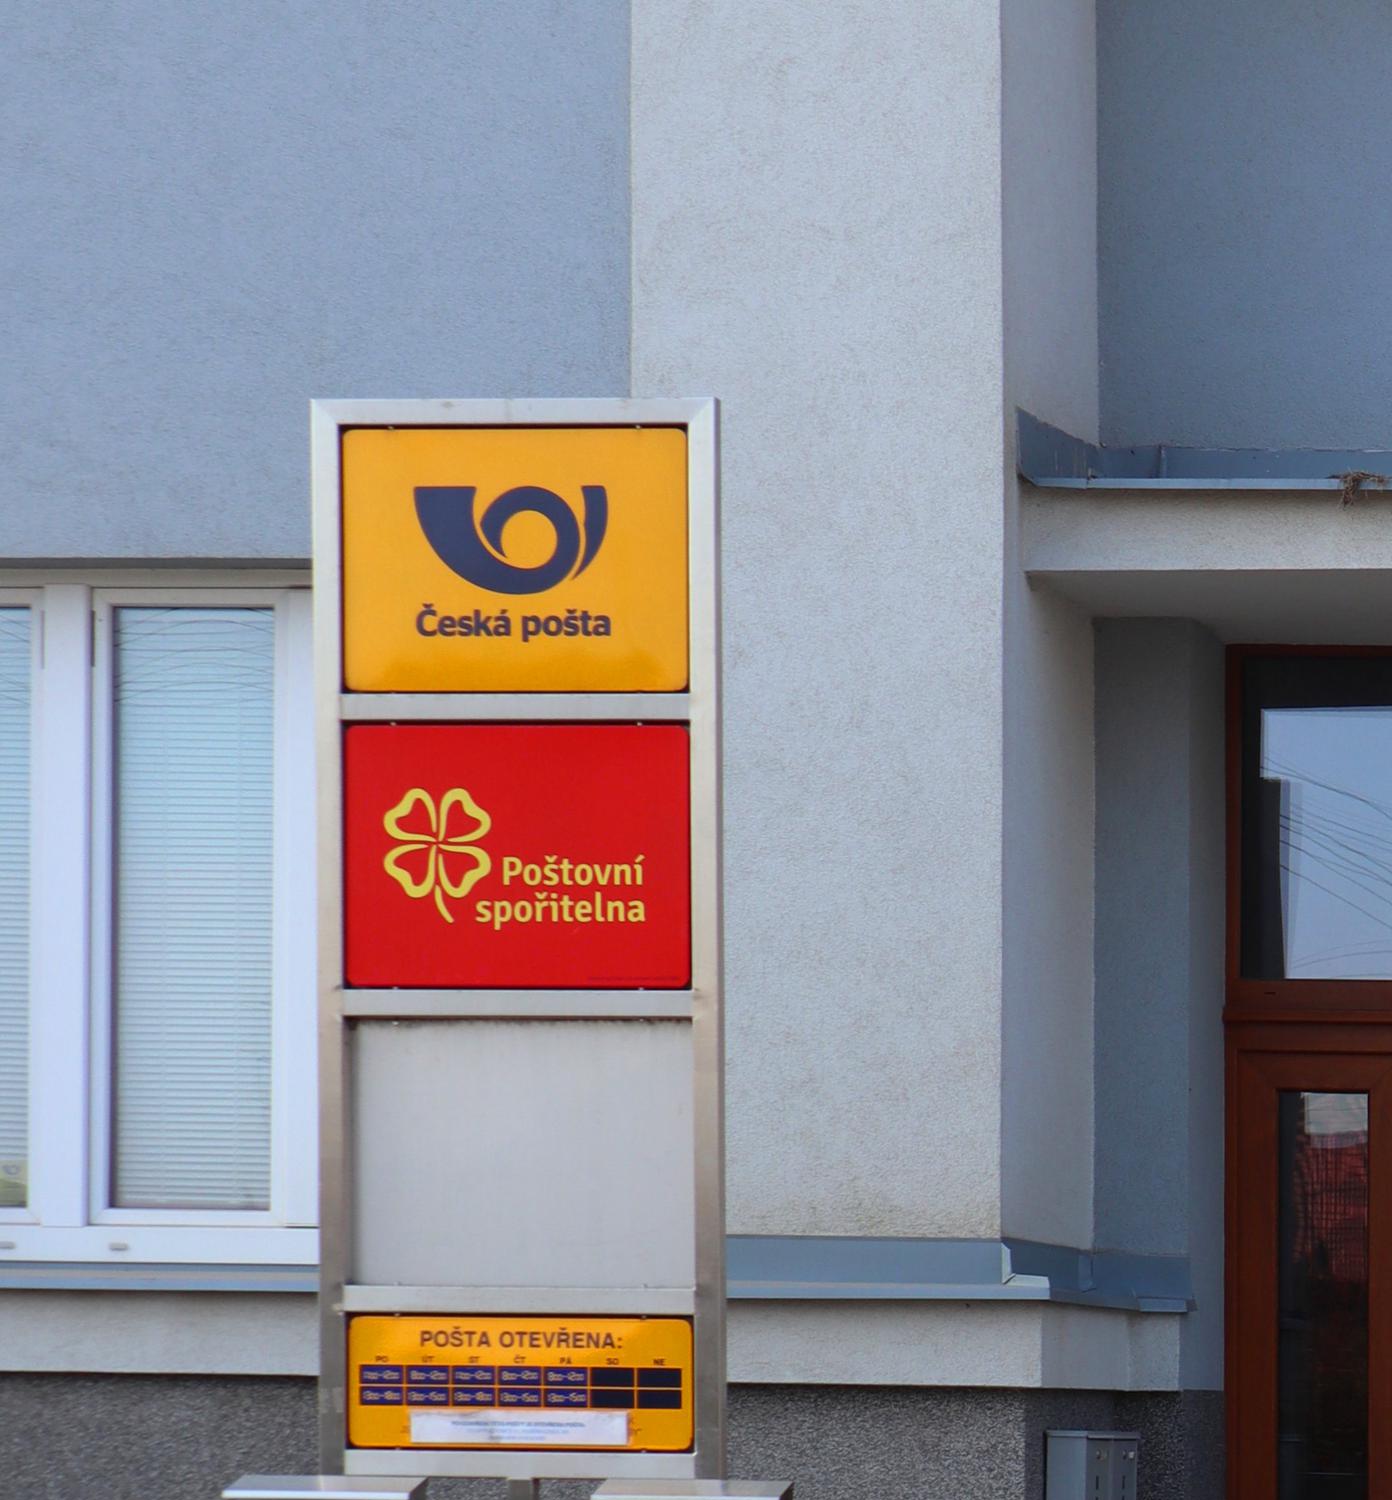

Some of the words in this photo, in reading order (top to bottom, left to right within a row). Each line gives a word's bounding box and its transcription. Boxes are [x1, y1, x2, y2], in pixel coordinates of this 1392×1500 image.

[416, 603, 512, 637] Česká
[521, 608, 612, 643] pošta
[502, 854, 646, 886] Poštovní
[475, 891, 646, 931] spořitelna
[420, 1327, 491, 1348] POŠTA
[499, 1328, 623, 1349] OTEVŘENA:
